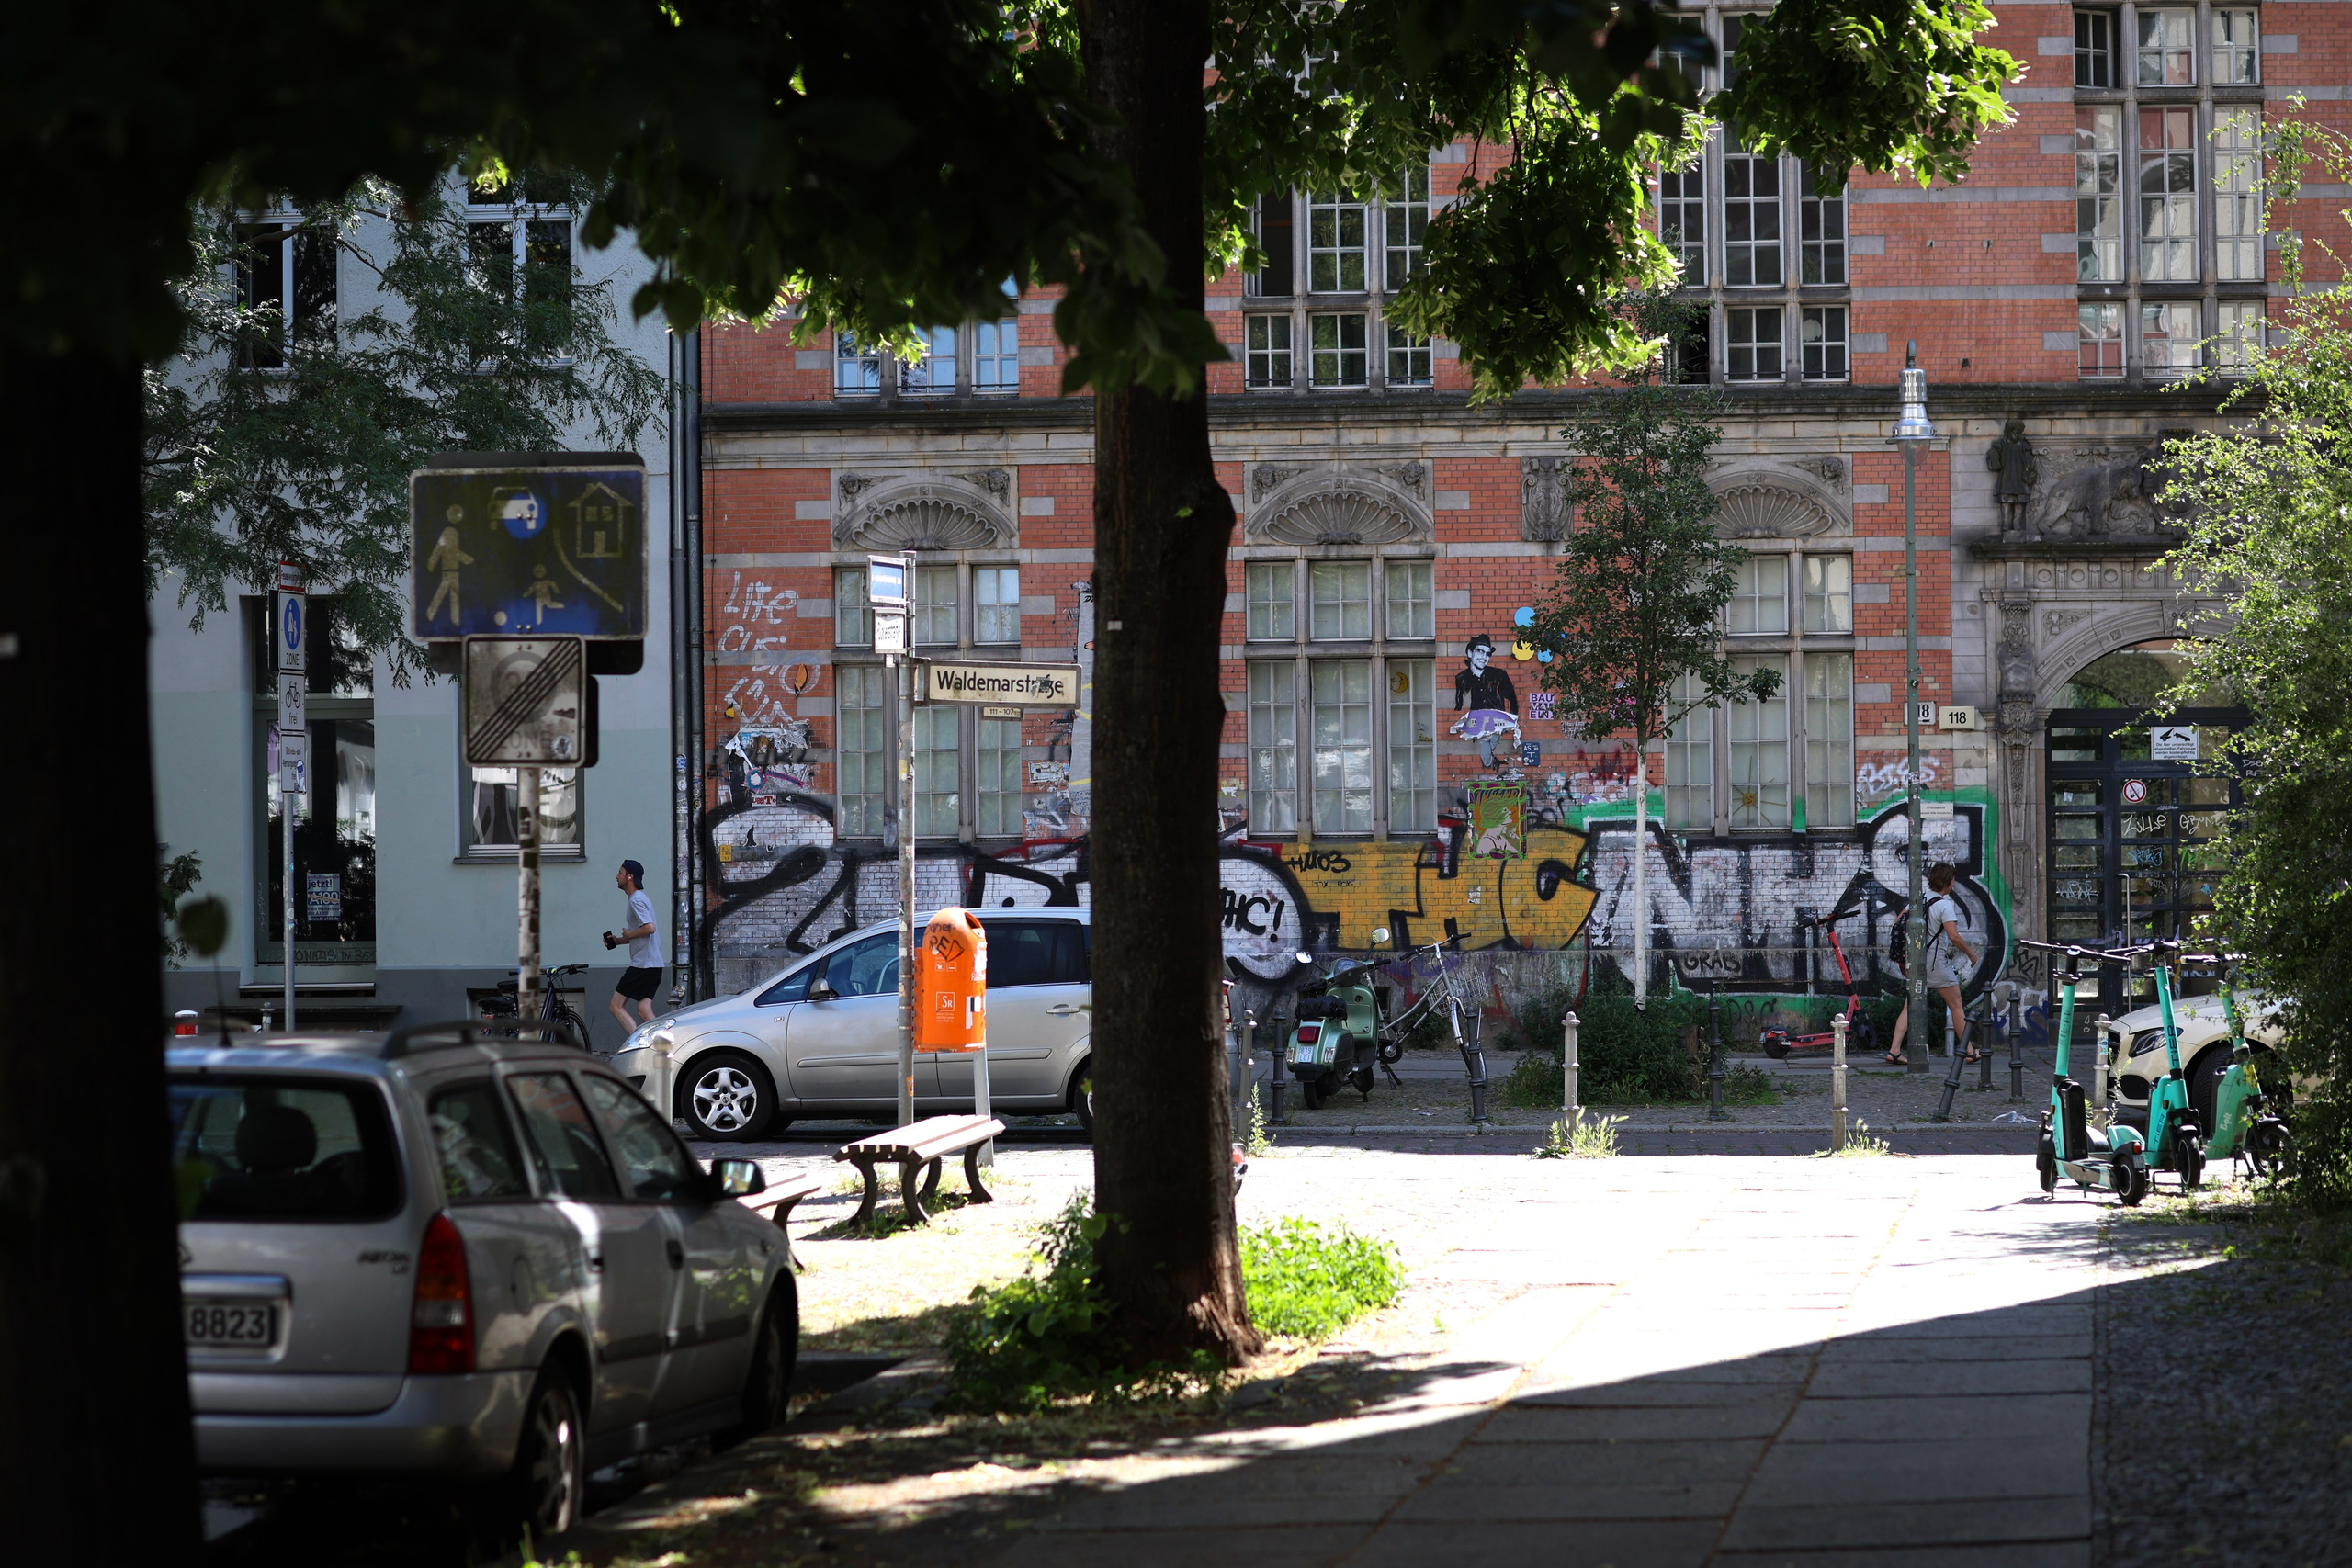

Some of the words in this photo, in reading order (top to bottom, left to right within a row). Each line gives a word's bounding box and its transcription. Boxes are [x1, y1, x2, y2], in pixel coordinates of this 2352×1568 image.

[287, 653, 300, 666] ZONE
[937, 670, 1064, 699] Waldemarstße
[1531, 694, 1553, 702] BAU
[289, 713, 298, 725] frei
[1949, 712, 1967, 724] 118
[308, 879, 333, 890] jetzt!
[310, 891, 339, 905] A100
[305, 949, 337, 961] NAZIS
[2166, 1024, 2180, 1066] TIER
[2220, 1112, 2233, 1131] Bolt
[2154, 1113, 2165, 1145] TIER
[191, 1308, 265, 1339] 8823
